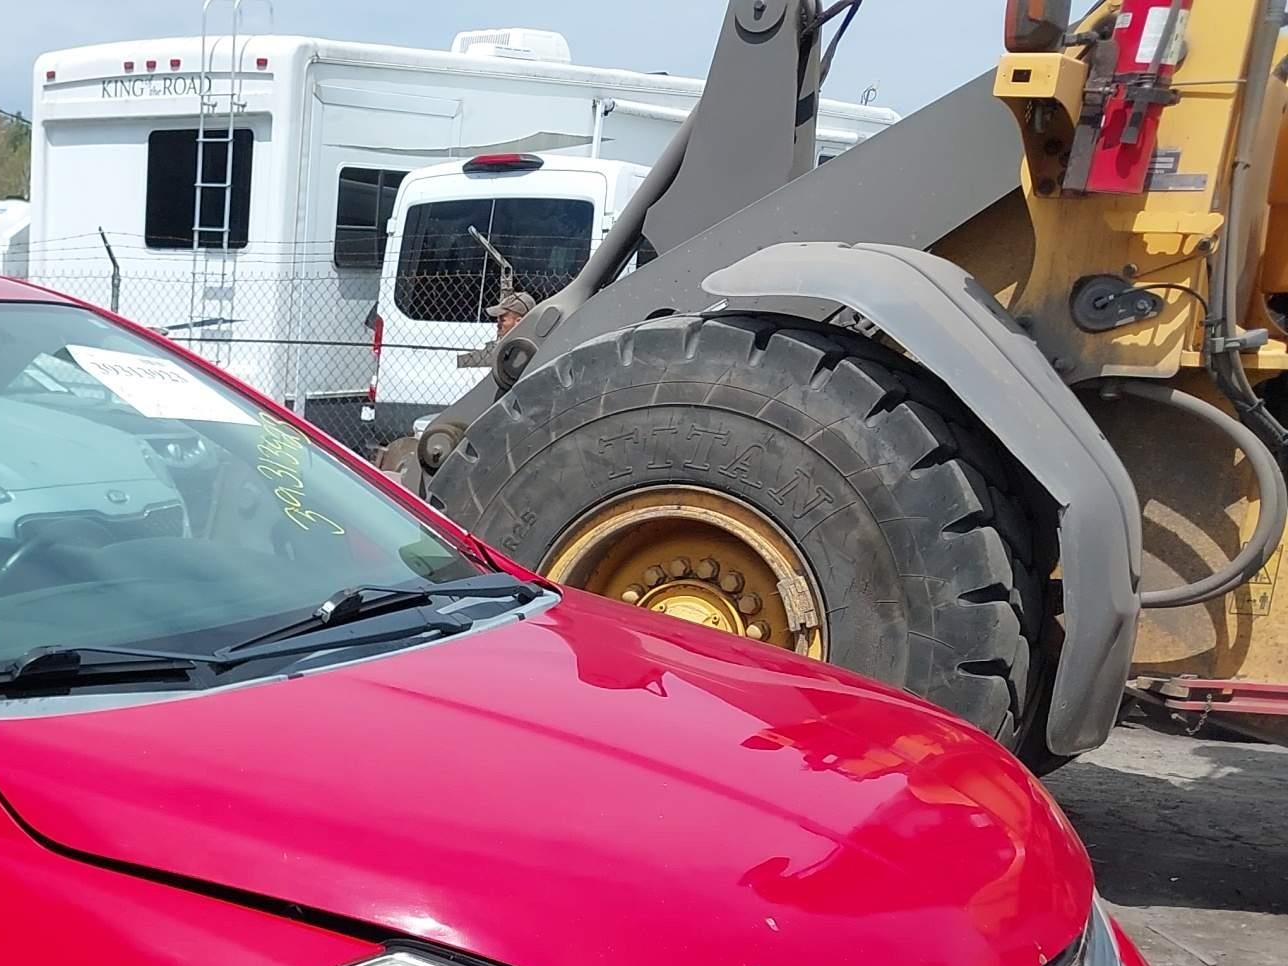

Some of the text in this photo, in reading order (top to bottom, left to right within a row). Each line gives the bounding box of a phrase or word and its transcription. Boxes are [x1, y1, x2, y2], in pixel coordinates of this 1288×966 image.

[101, 78, 144, 98] KING
[162, 76, 212, 96] ROAD
[598, 423, 834, 519] TITAN
